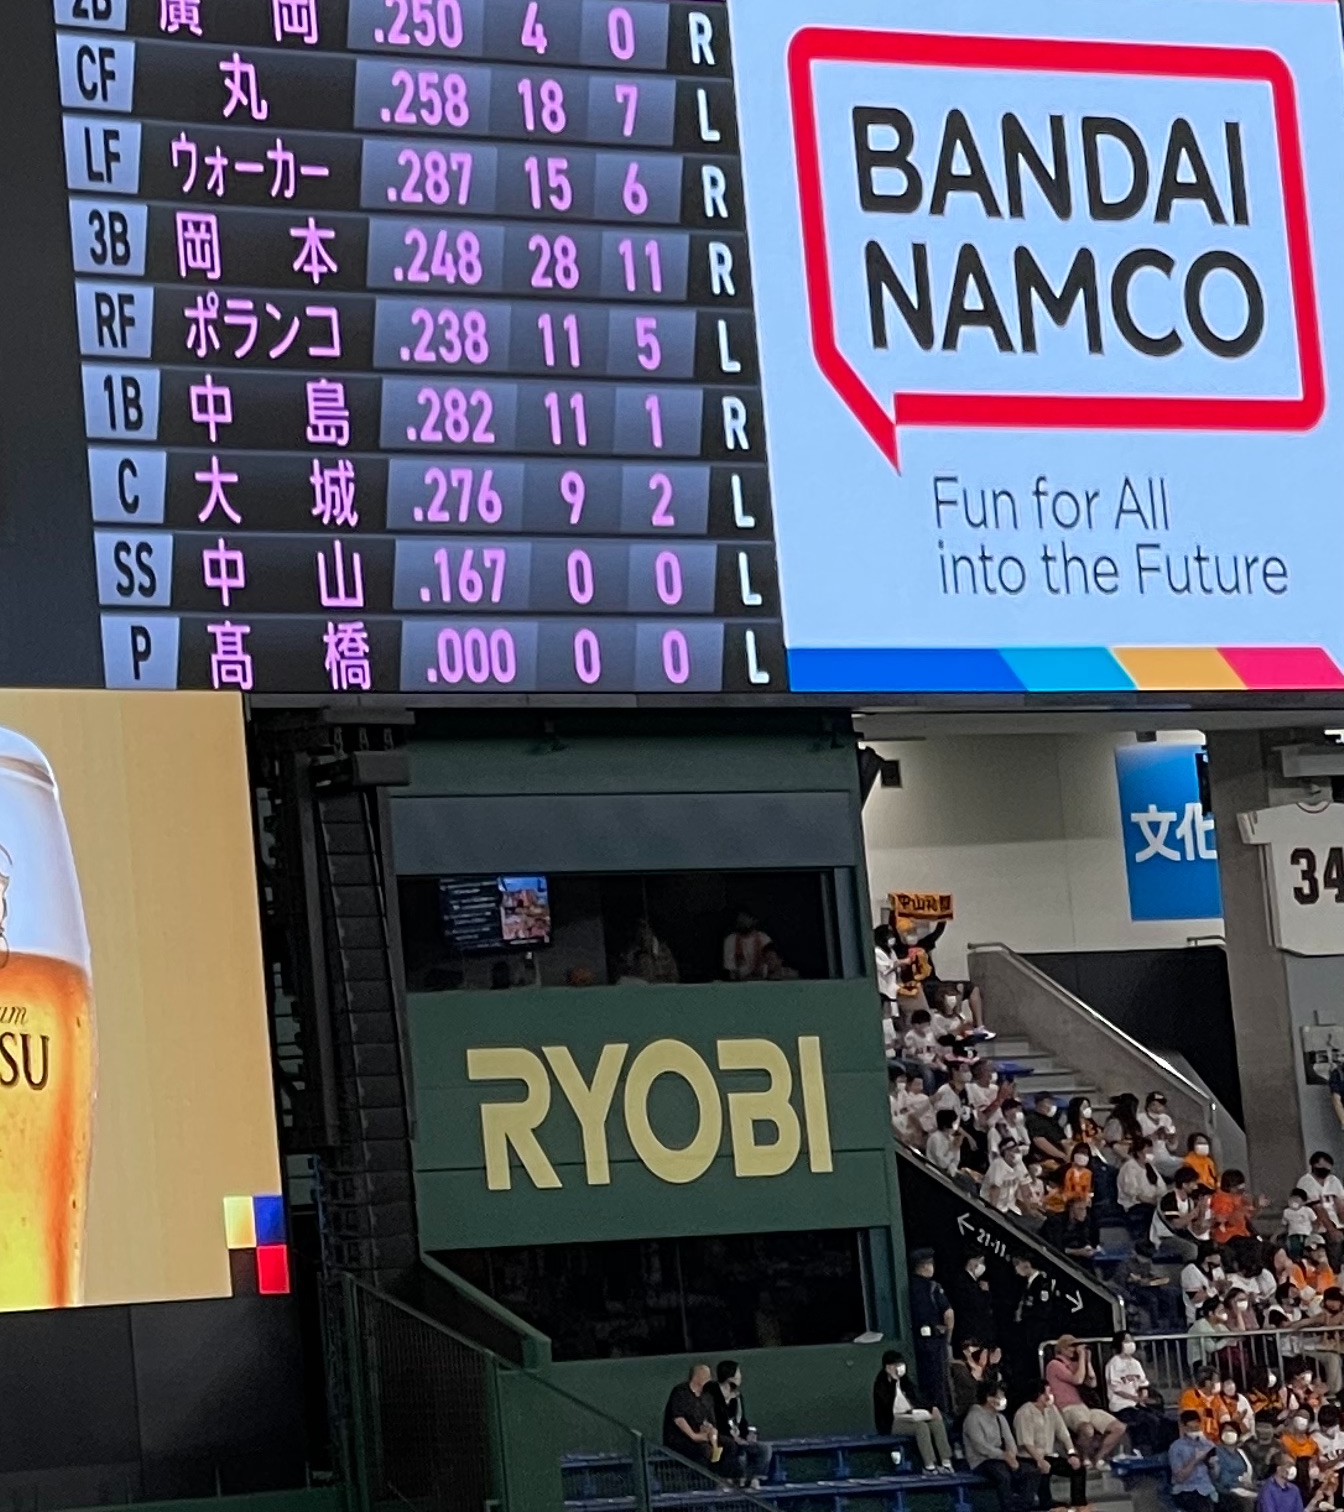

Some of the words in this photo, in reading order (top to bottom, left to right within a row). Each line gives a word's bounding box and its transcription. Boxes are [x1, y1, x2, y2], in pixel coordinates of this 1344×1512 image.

[75, 43, 117, 104] CF
[219, 51, 270, 122] 丸
[379, 69, 471, 129] .258
[516, 77, 566, 136] 18
[84, 127, 122, 184] LF
[170, 130, 330, 201] ウォーカー
[385, 147, 474, 208] .287
[523, 155, 573, 214] 15
[851, 104, 1251, 227] BANDAI
[88, 207, 132, 267] 3B
[392, 227, 484, 286] .248
[528, 233, 580, 290] 28
[95, 291, 137, 350] RF
[183, 290, 343, 361] ポランコ
[398, 307, 491, 365] .238
[536, 312, 581, 369] 11
[863, 239, 1267, 359] NAMCO
[102, 373, 144, 433] 1B
[405, 387, 497, 445] .282
[543, 391, 588, 448] 11
[117, 456, 140, 516] C
[412, 466, 504, 526] .276
[933, 476, 1018, 531] Fun
[1032, 477, 1100, 531] for
[1114, 476, 1171, 532] All
[113, 539, 157, 599] SS
[418, 547, 507, 605] .167
[938, 540, 1028, 595] into
[1042, 542, 1121, 595] the
[1136, 542, 1290, 596] Future
[130, 624, 153, 681] P
[426, 626, 517, 685] .000
[1130, 802, 1218, 864] 文化
[1290, 846, 1344, 905] 34
[466, 1034, 835, 1192] RYOBI
